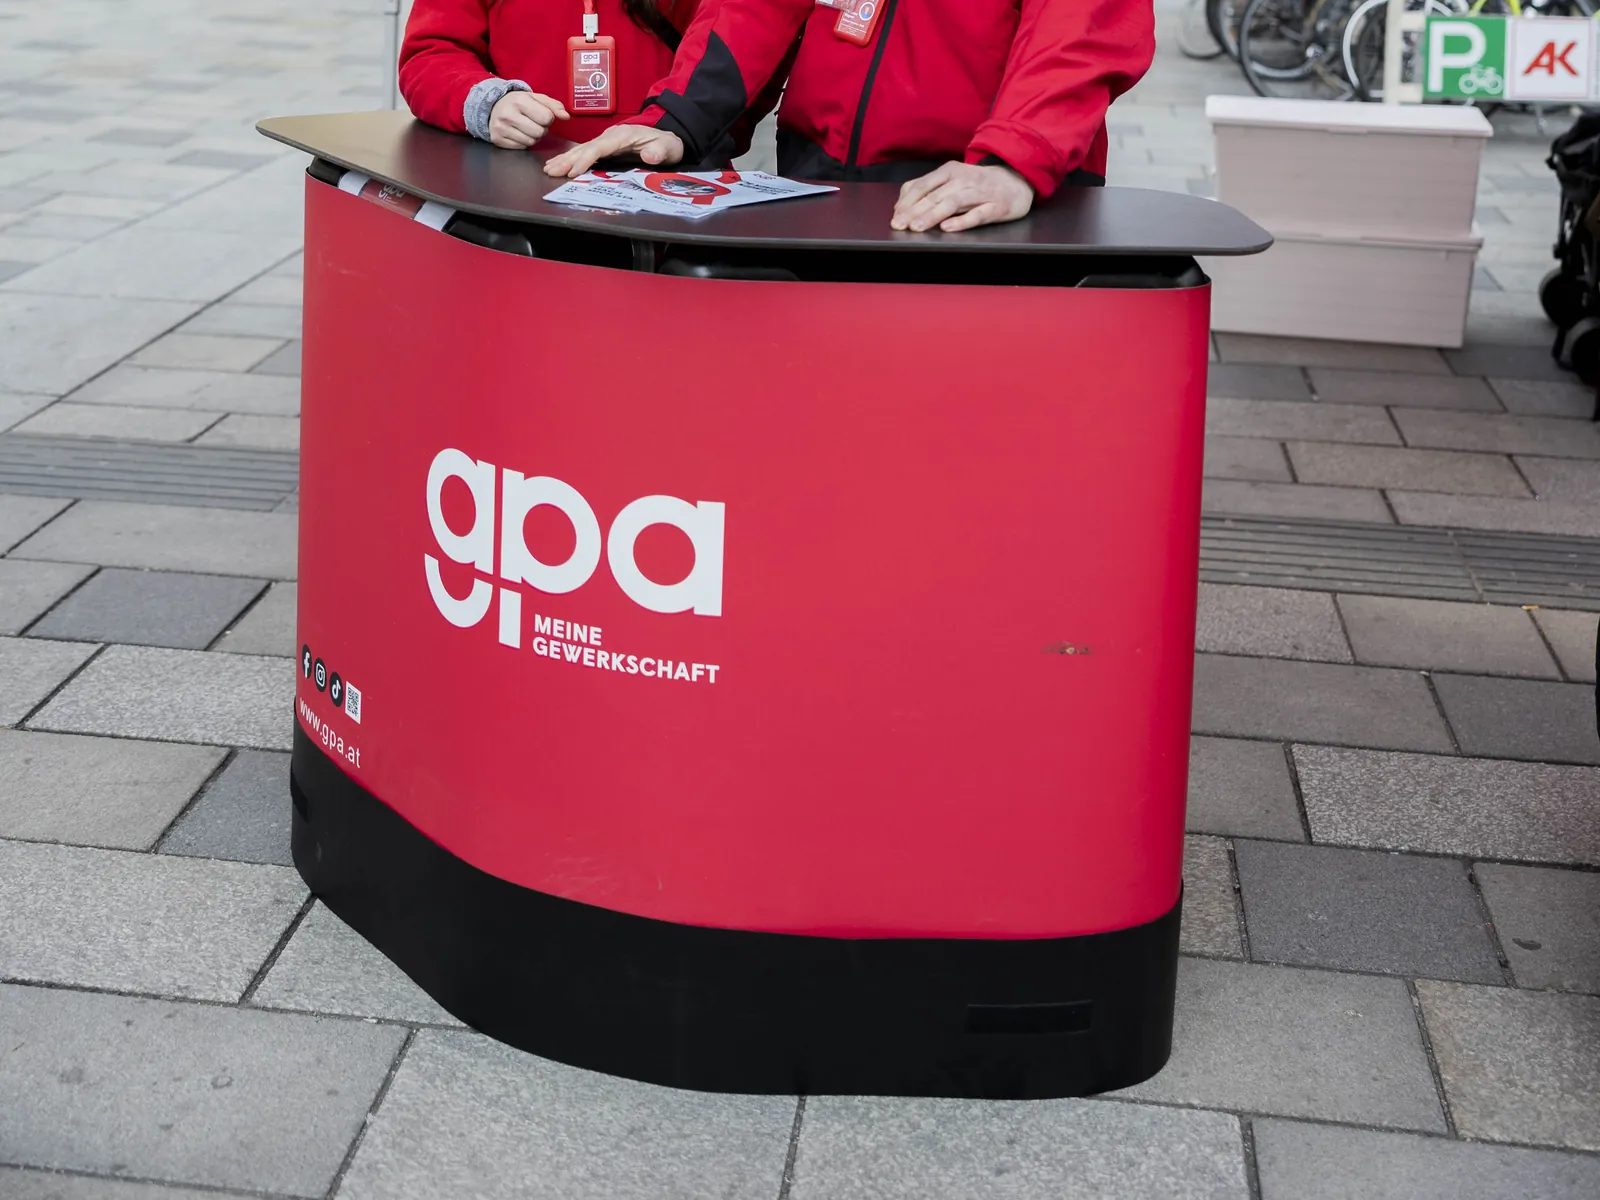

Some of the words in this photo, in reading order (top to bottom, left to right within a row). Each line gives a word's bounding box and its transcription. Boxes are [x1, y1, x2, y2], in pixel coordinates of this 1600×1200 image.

[1428, 21, 1486, 93] P
[1522, 41, 1579, 77] AK
[424, 448, 725, 649] gpa
[534, 614, 602, 645] MEINE
[532, 637, 720, 683] GEWERKSCHAFT
[300, 697, 360, 768] www.gpa.at
